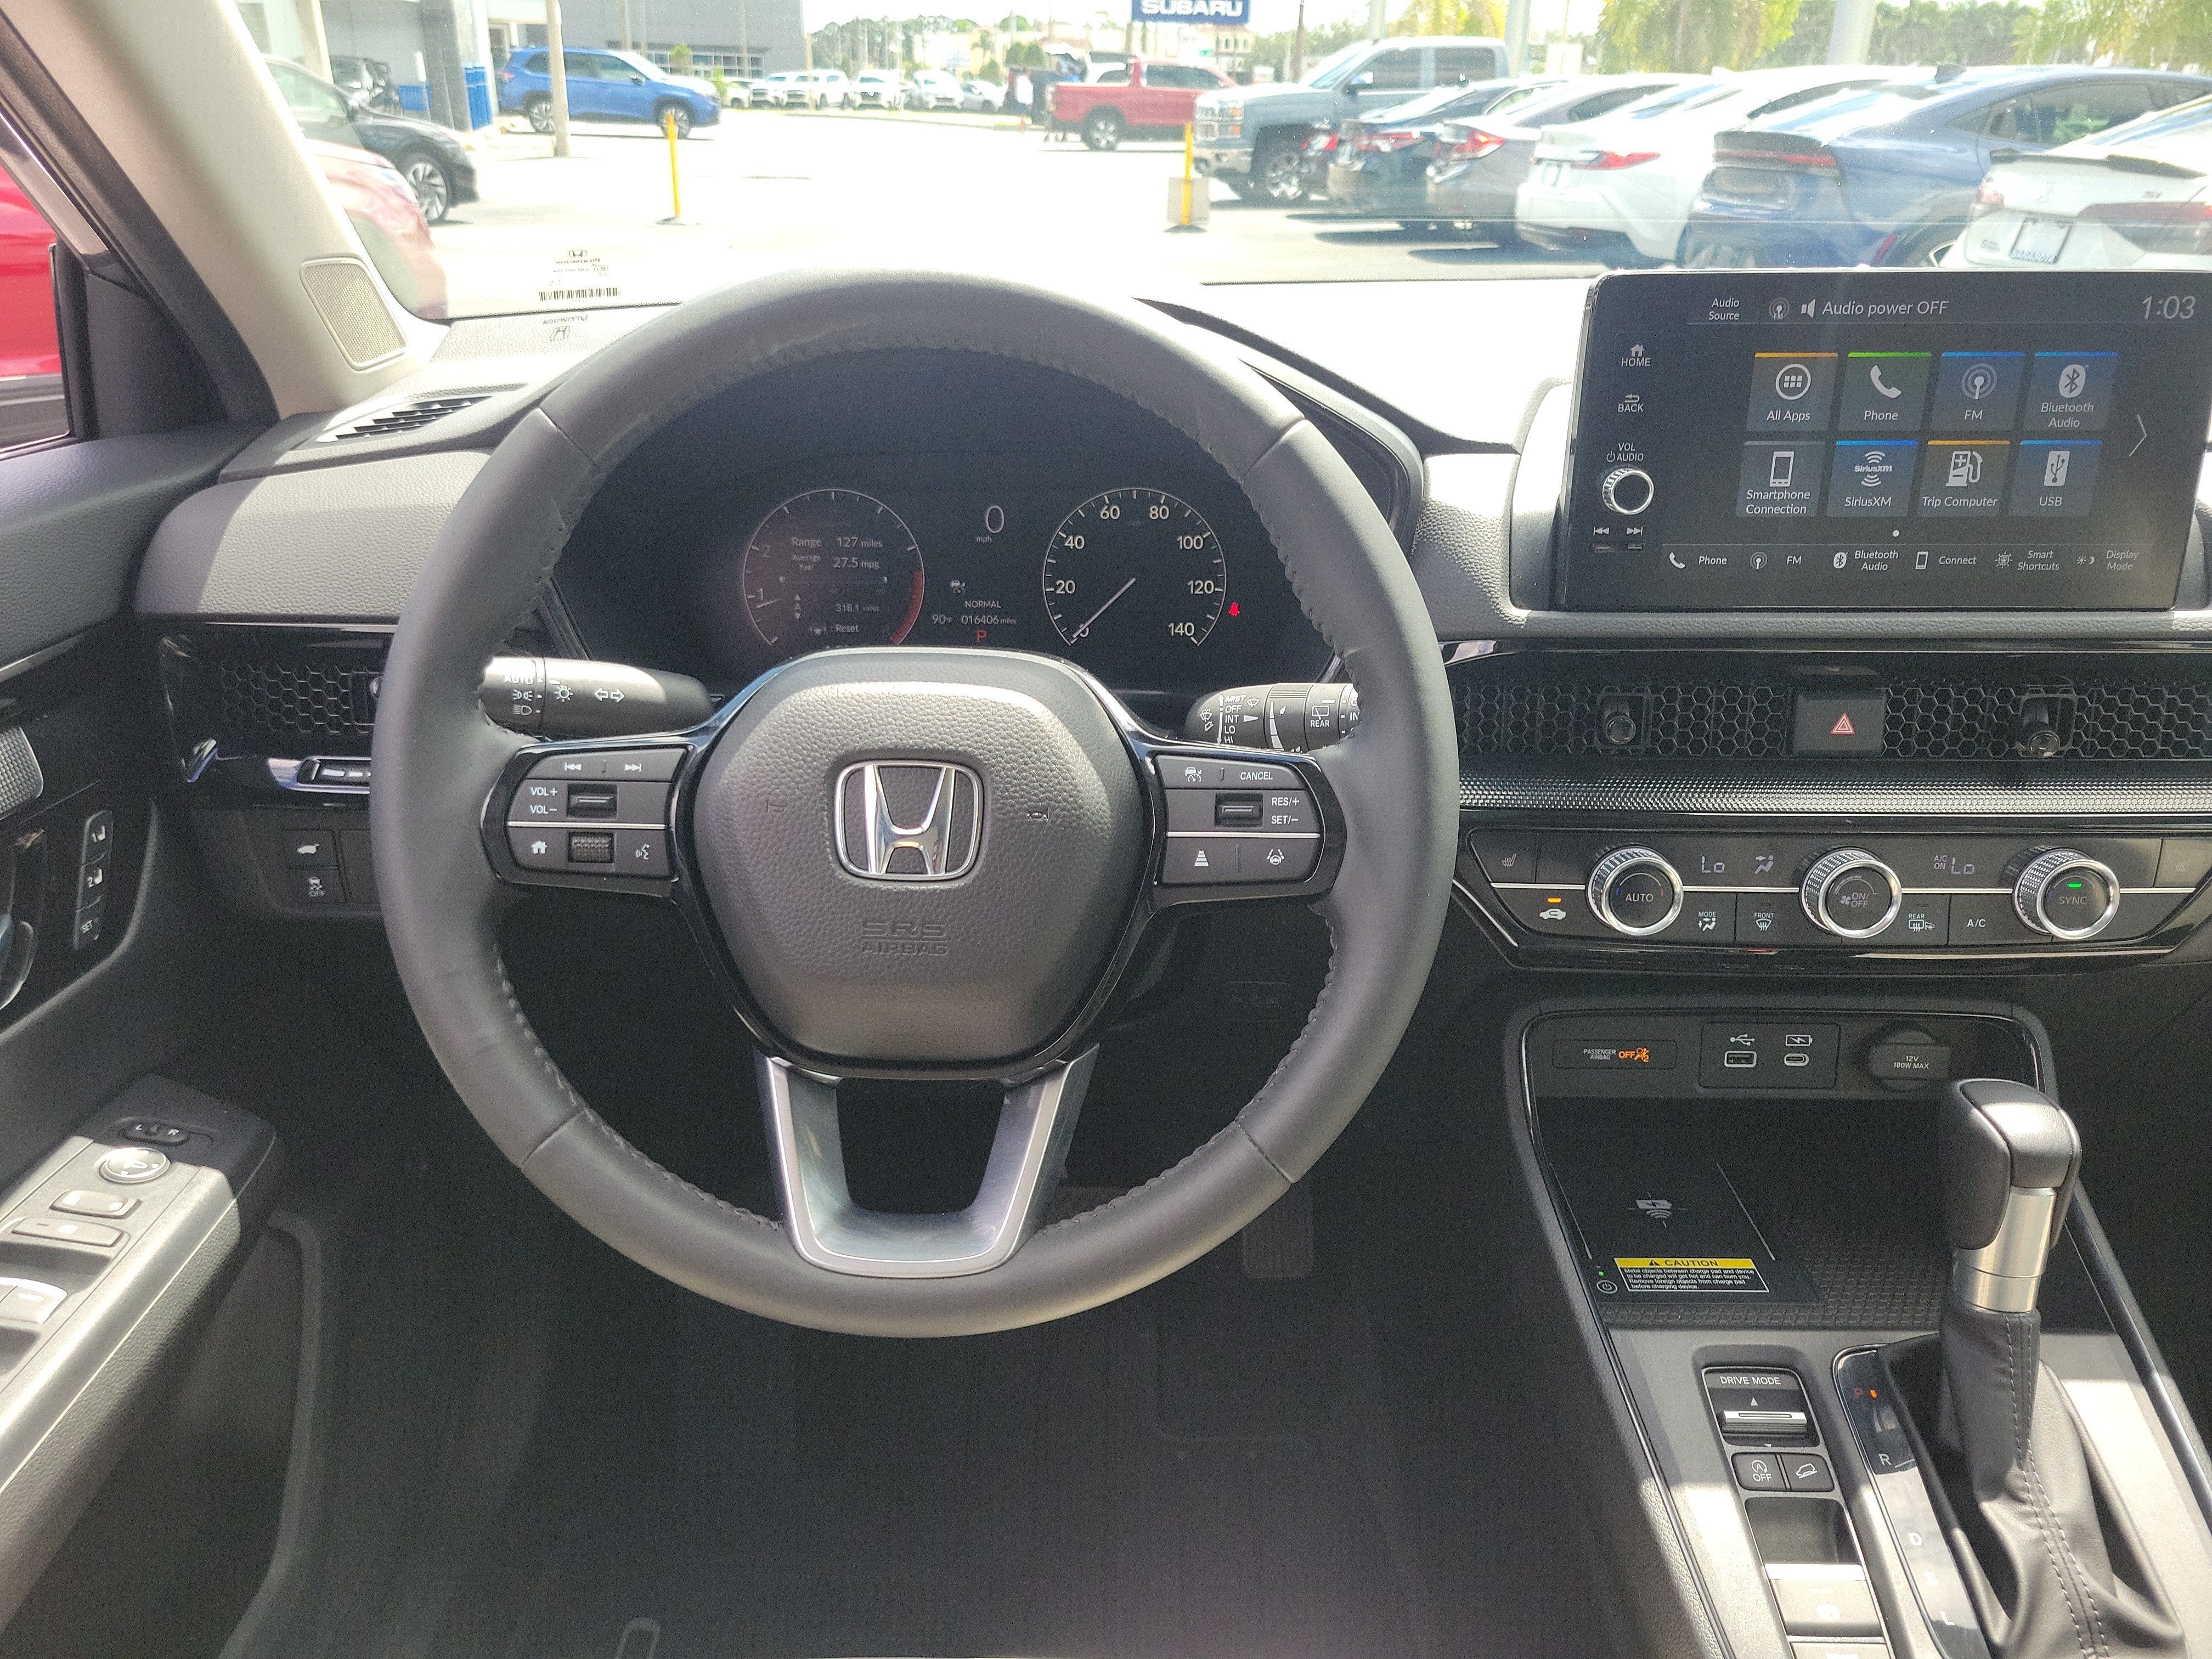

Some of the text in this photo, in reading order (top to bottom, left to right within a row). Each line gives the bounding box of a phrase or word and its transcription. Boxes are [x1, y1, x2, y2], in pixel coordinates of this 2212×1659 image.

[1142, 0, 1243, 16] SUBARU
[1711, 297, 1740, 308] Audio
[2141, 296, 2196, 319] 1:03
[1821, 301, 1949, 318] Audio power OFF
[1708, 311, 1740, 321] Source
[1621, 357, 1651, 367] HOME
[1617, 403, 1644, 413] BACK
[2041, 402, 2095, 413] Bluetooth
[1766, 410, 1811, 423] All Apps
[1864, 410, 1898, 421] Phone
[1964, 410, 1983, 420] FM
[2048, 417, 2081, 428] Audio
[1617, 442, 1636, 452] VOL
[1616, 452, 1644, 462] AUDIO
[1746, 489, 1811, 501] Smartphone
[1844, 496, 1892, 507] SiriusXM
[1922, 496, 1998, 508] Trip Computer
[2039, 496, 2063, 507] USB
[1100, 505, 1121, 520] 60
[1149, 505, 1170, 520] 80
[1745, 504, 1807, 515] Connection
[791, 537, 822, 548] Range
[836, 537, 883, 548] 127 miles
[975, 535, 992, 544] mph
[1064, 535, 1085, 550] 40
[1176, 535, 1204, 550] 100
[792, 554, 822, 563] Average
[1698, 555, 1728, 566] Phone
[1854, 550, 1899, 560] Bluetooth
[1938, 555, 1977, 566] Connect
[2027, 550, 2054, 560] Smart
[2106, 550, 2139, 561] Display
[833, 557, 880, 570] 27.5 mpg
[1786, 556, 1802, 566] FM
[1860, 561, 1889, 571] Audio
[2016, 561, 2061, 571] Shortcuts
[2106, 561, 2134, 571] Mode
[1055, 580, 1076, 595] 20
[1187, 579, 1215, 595] 120
[964, 600, 1002, 608] NORMAL
[961, 615, 1000, 625] 016406
[836, 624, 860, 633] Reset
[1167, 622, 1195, 637] 140
[975, 629, 988, 643] P
[504, 674, 534, 685] AUTO
[1224, 704, 1243, 714] OFF
[1224, 714, 1240, 724] INT
[1310, 719, 1330, 728] REAR
[1224, 725, 1236, 734] LO
[1224, 735, 1234, 744] HI
[1240, 771, 1273, 781] CANCEL
[1271, 797, 1300, 806] RES/+
[1624, 893, 1655, 902] AUTO
[2058, 895, 2087, 905] SYNC
[1851, 900, 1869, 908] OFF
[81, 919, 93, 934] SET
[1967, 918, 1986, 928] A/C
[862, 921, 948, 938] SRS
[861, 940, 949, 956] AIRBAG
[1618, 1050, 1635, 1059] OFF
[1719, 1376, 1781, 1386] DRIVE MODE
[1878, 1453, 1893, 1466] R
[1752, 1473, 1773, 1482] OFF
[1908, 1531, 1923, 1547] D
[1940, 1611, 1955, 1626] L
